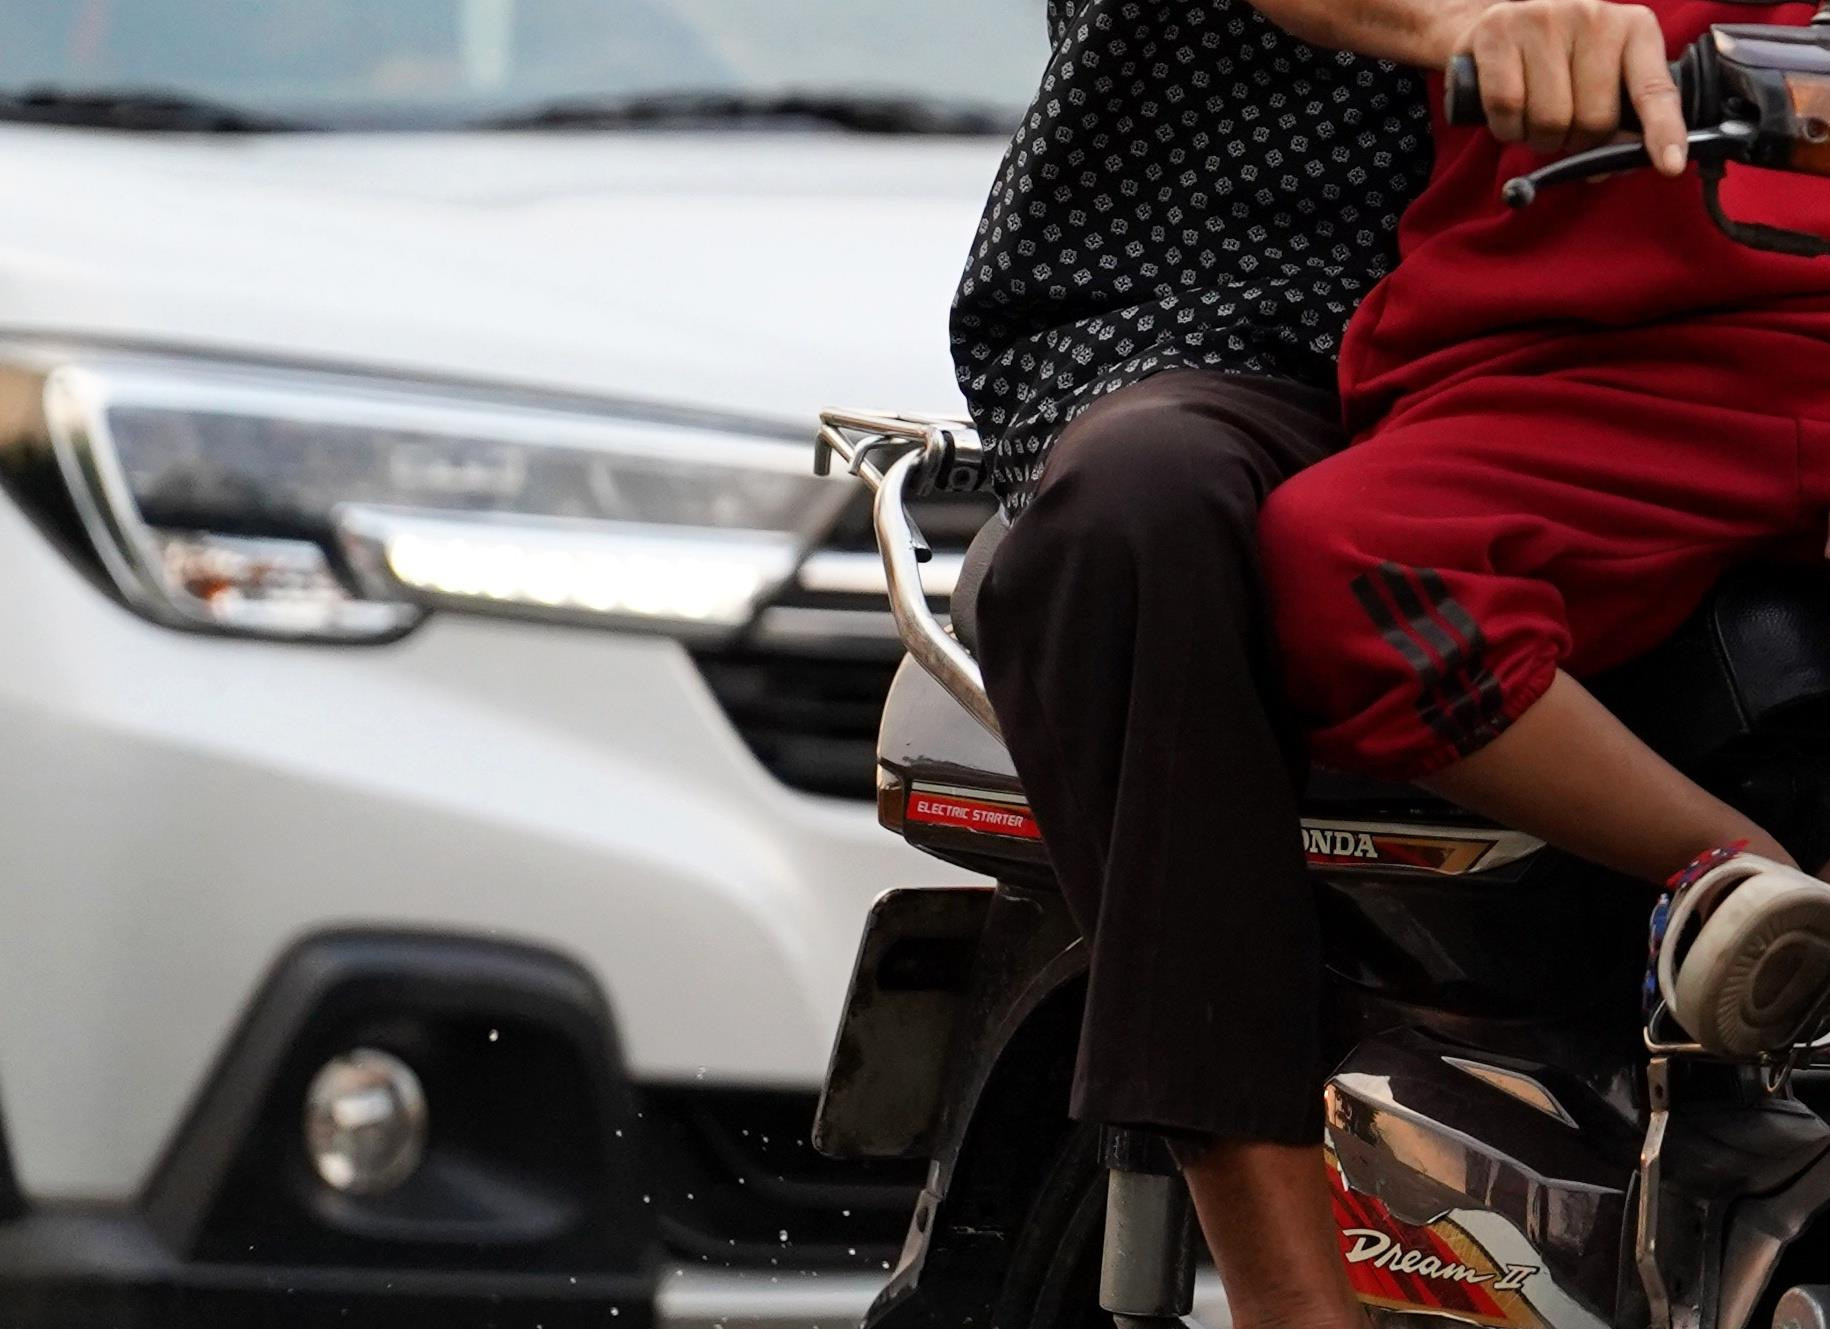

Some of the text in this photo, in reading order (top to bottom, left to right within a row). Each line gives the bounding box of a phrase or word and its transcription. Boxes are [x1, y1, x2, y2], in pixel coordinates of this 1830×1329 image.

[916, 800, 1024, 828] ELECTRIC STARTER
[1342, 1228, 1496, 1283] Dream
